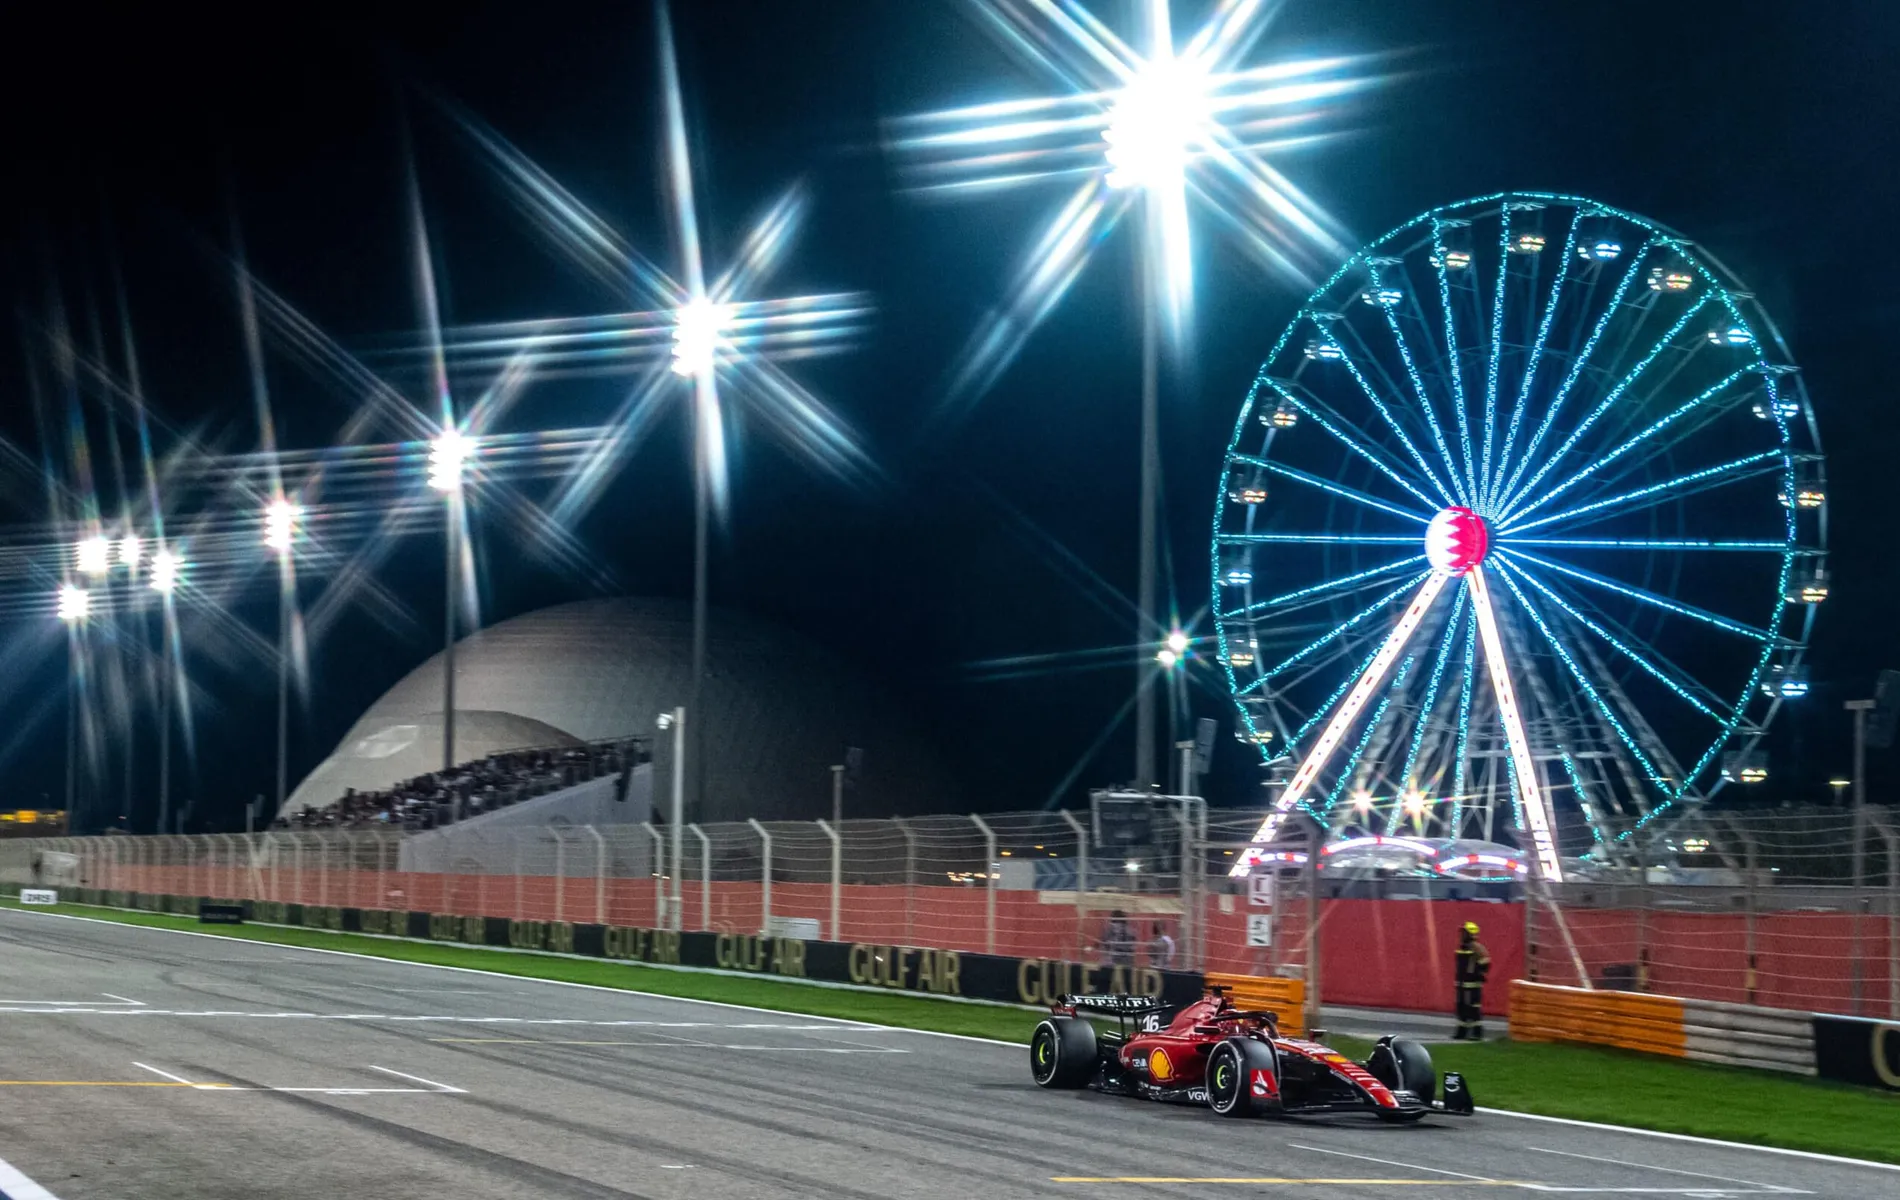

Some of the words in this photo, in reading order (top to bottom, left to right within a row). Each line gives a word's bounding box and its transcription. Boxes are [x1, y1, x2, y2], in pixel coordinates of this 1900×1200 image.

[605, 925, 648, 960] GULF
[715, 933, 766, 971] GULF
[770, 937, 807, 977] AIR
[850, 943, 914, 988] GULF
[917, 948, 961, 994] AIR
[1018, 958, 1100, 1005] GULF
[1142, 1014, 1160, 1032] 16
